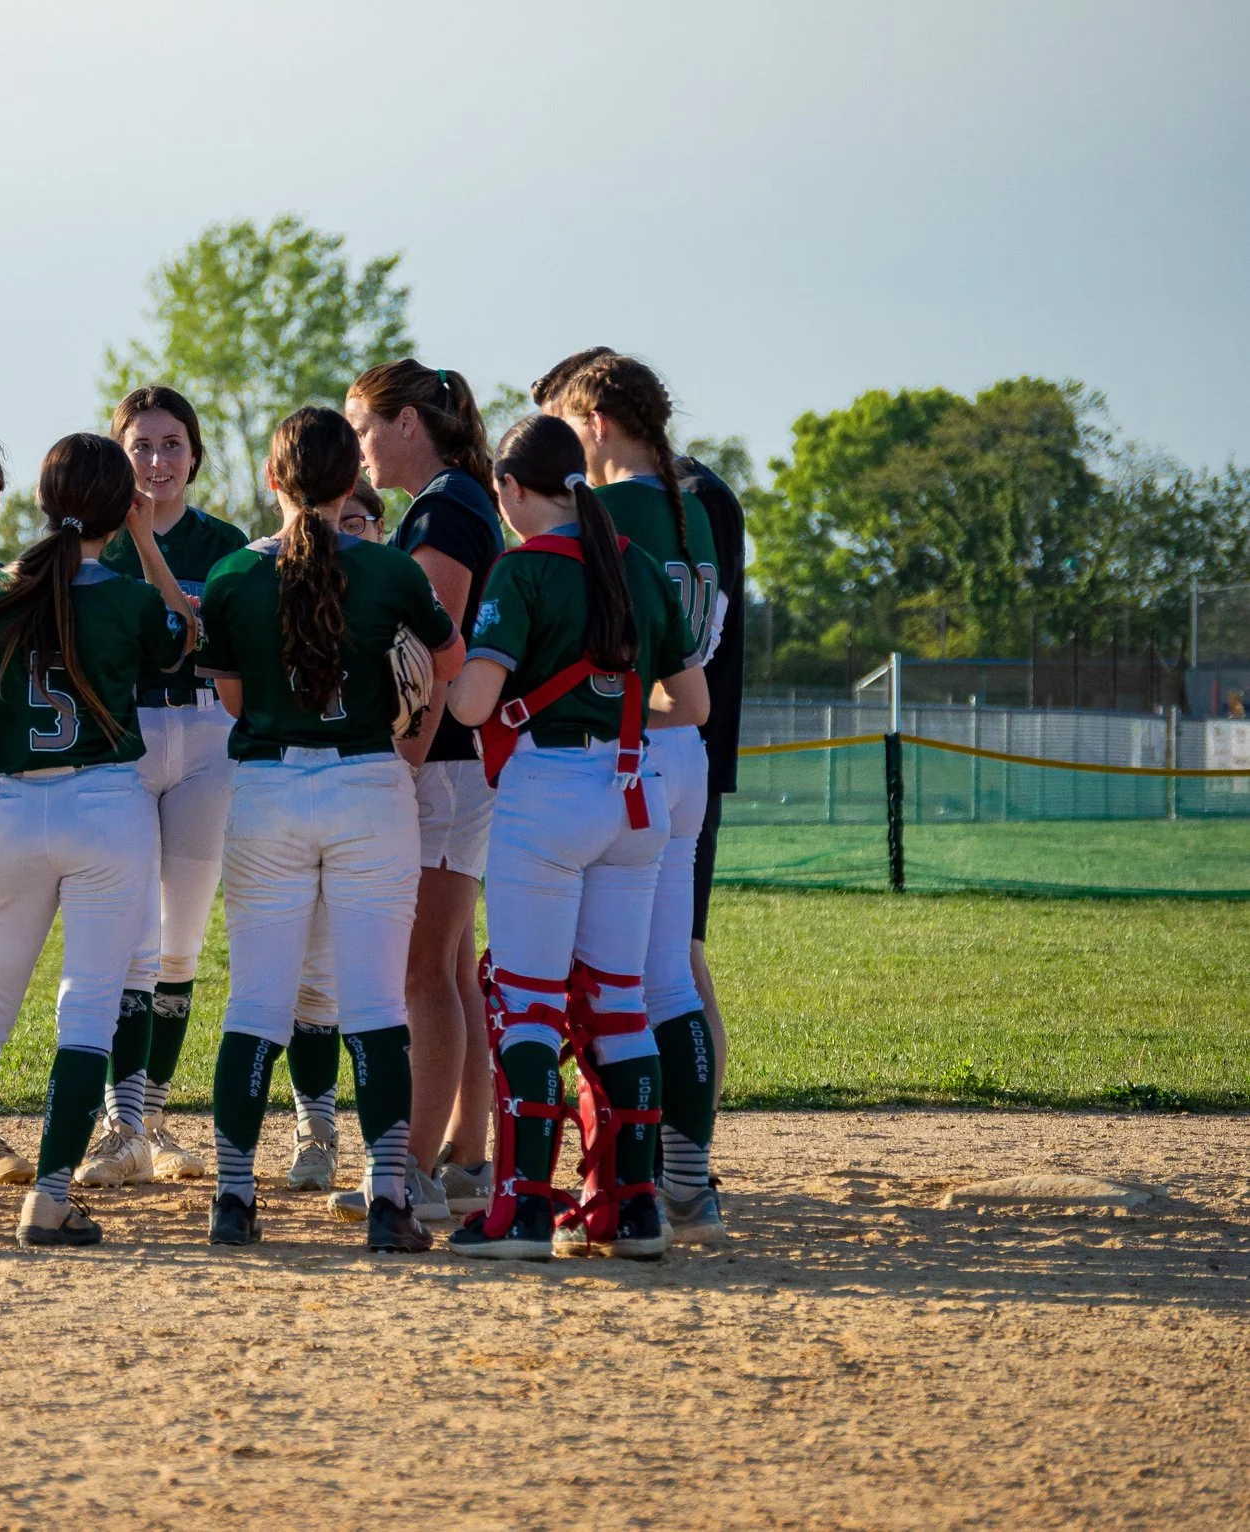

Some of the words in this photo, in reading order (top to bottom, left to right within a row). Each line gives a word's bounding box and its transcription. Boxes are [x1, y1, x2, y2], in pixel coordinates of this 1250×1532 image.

[29, 651, 80, 751] 5
[249, 1039, 271, 1097] COUGARS
[689, 1020, 709, 1083] COUGARS
[544, 1069, 558, 1137] COUGRS
[635, 1077, 651, 1140] COUGRS
